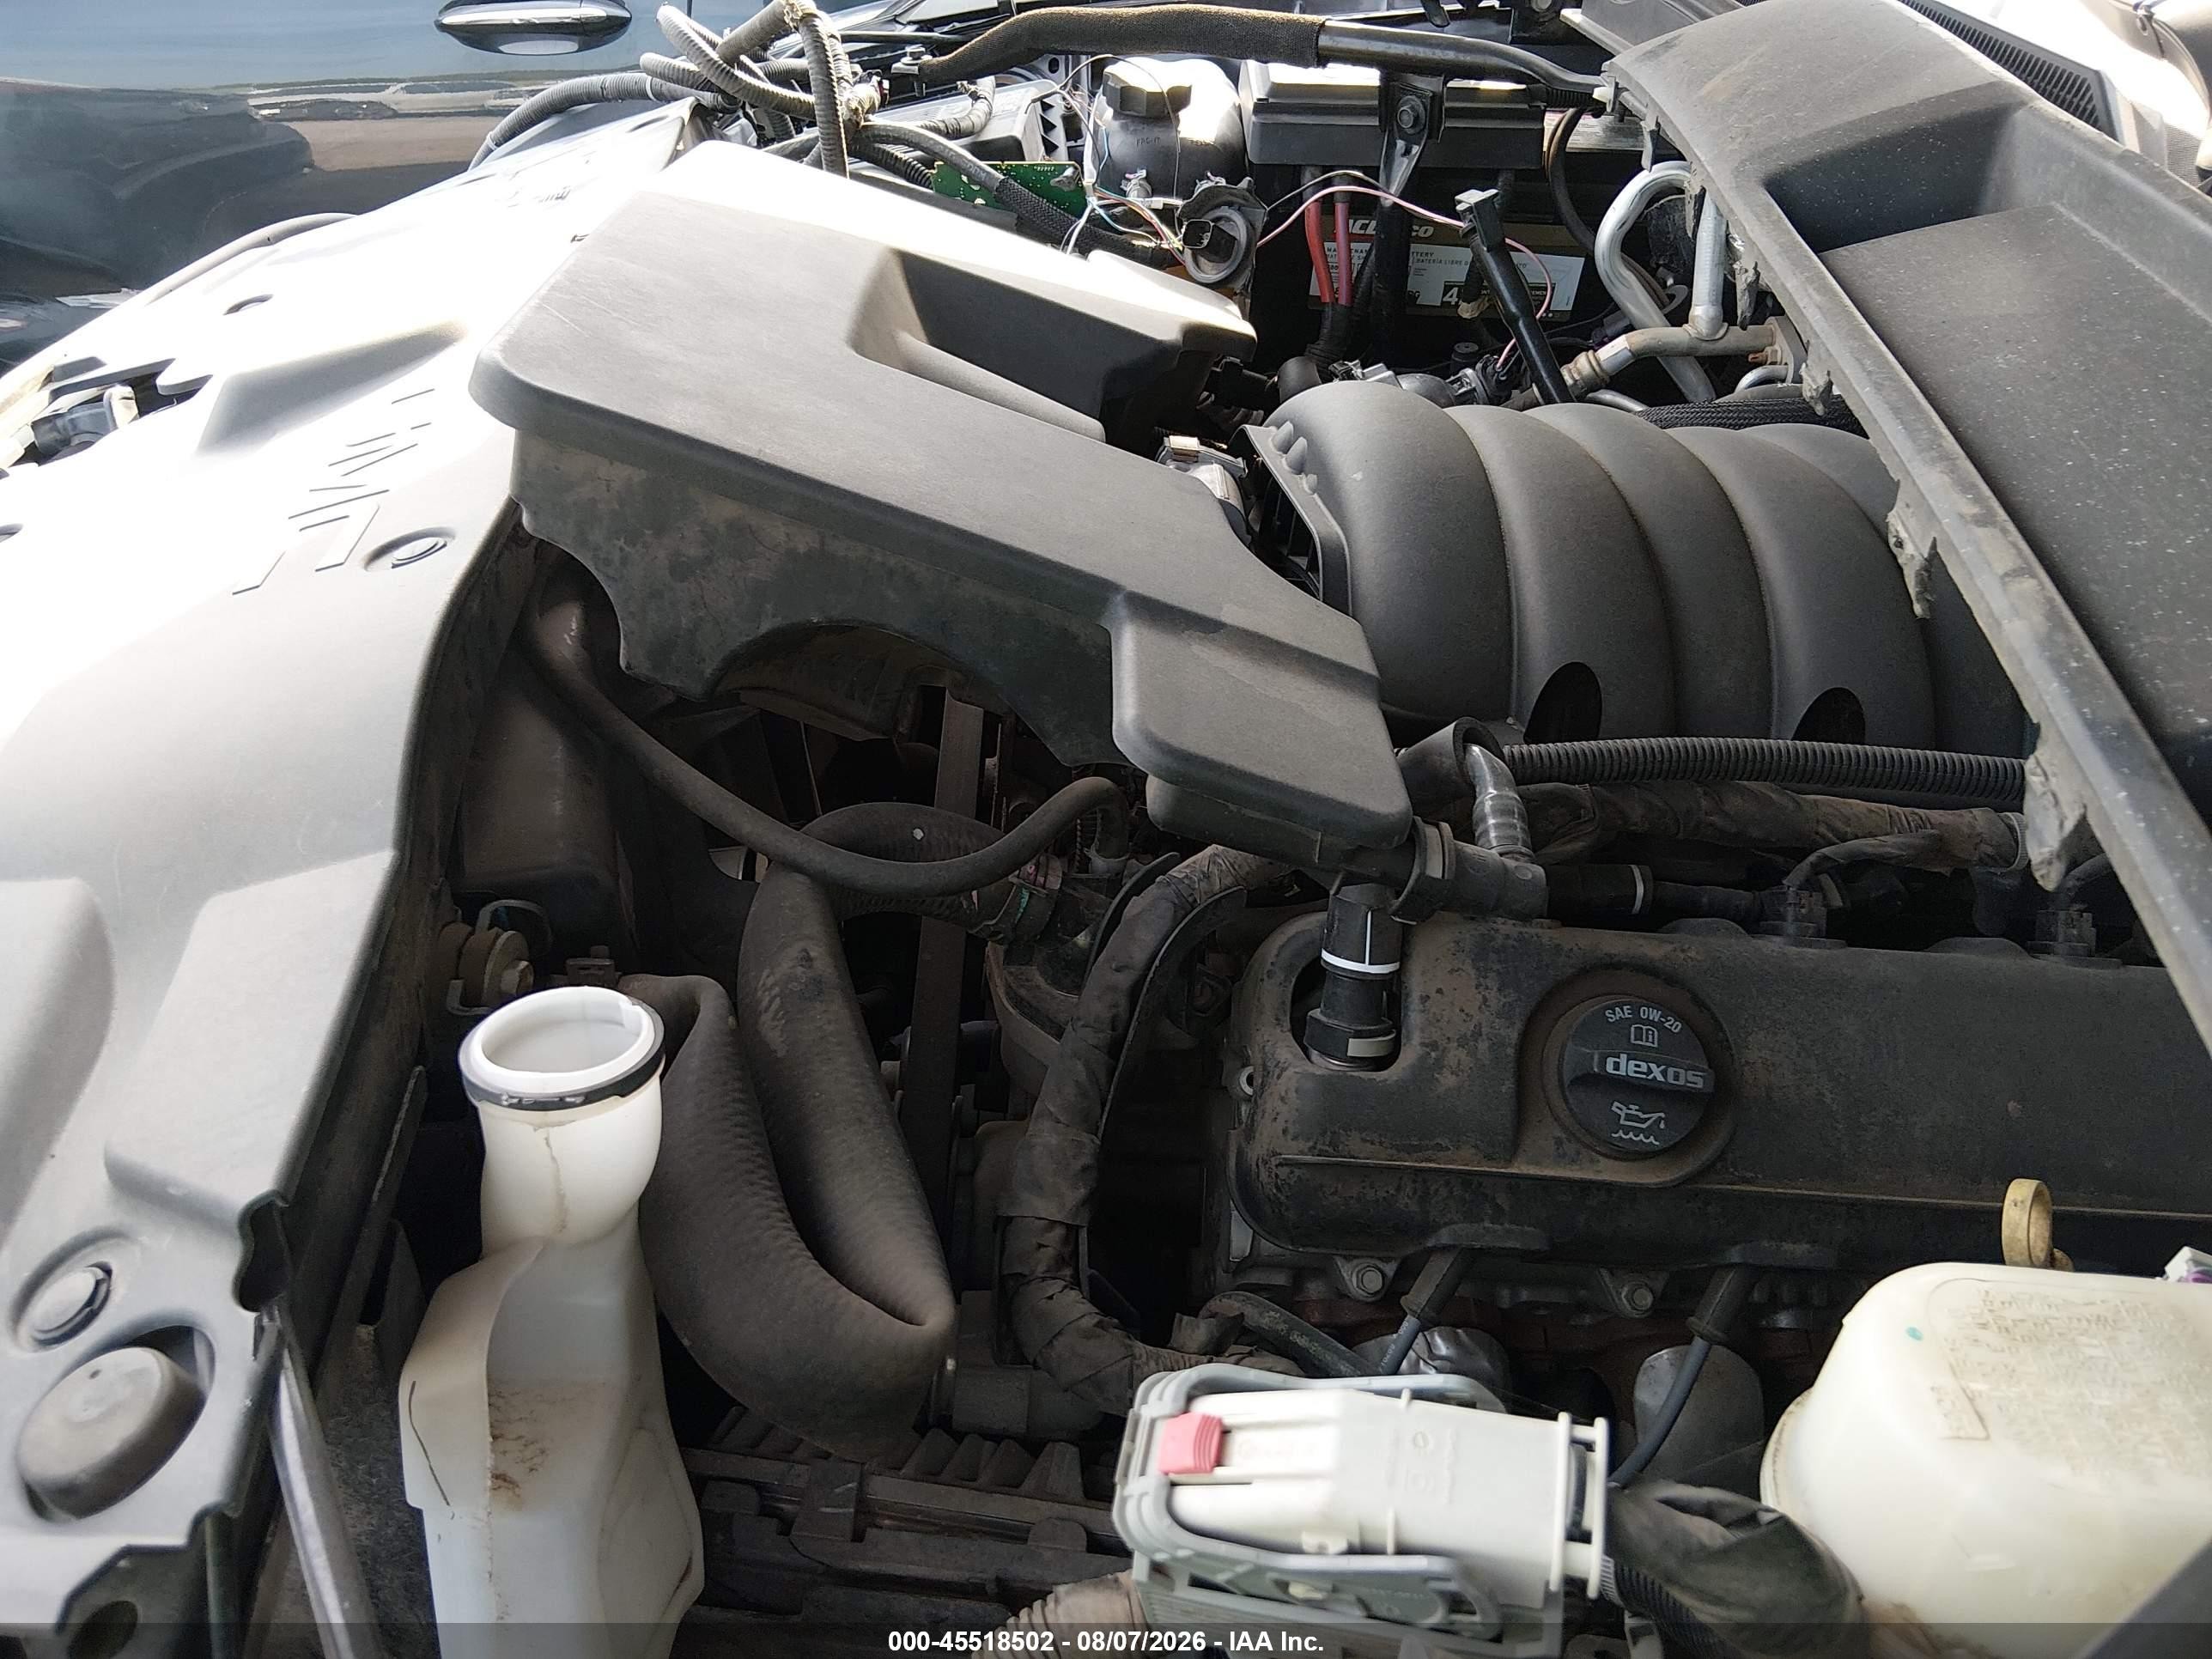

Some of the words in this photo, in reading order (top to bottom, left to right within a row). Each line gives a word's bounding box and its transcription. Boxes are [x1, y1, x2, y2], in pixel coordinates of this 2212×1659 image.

[1605, 1005, 1632, 1024] SAE
[1639, 1006, 1682, 1034] 0W-20
[1605, 1054, 1707, 1089] dexos
